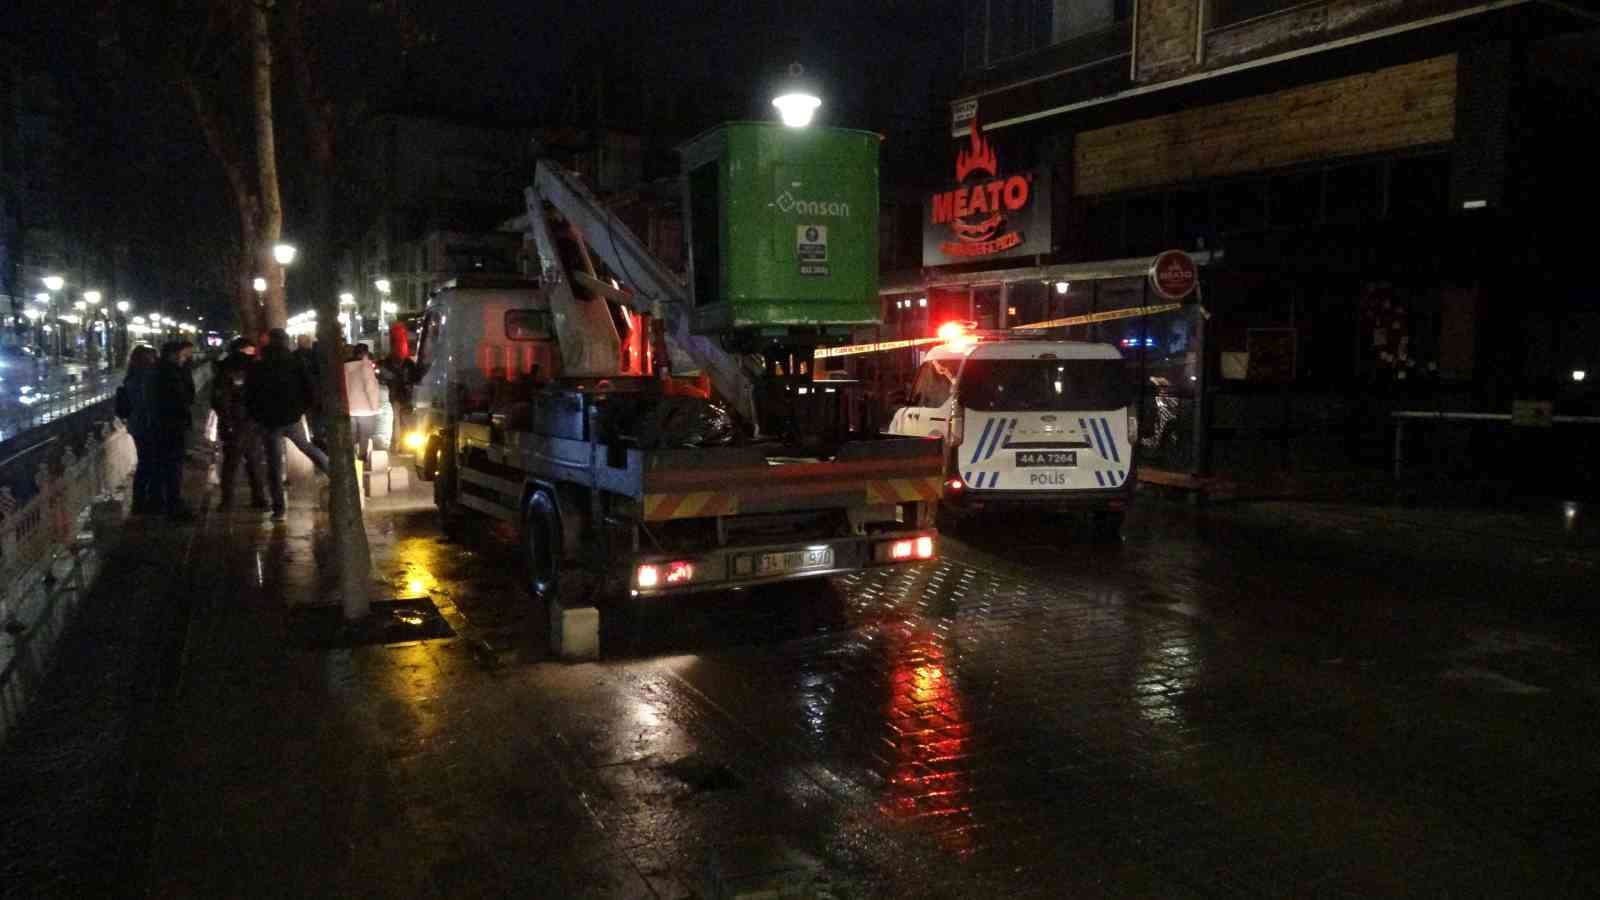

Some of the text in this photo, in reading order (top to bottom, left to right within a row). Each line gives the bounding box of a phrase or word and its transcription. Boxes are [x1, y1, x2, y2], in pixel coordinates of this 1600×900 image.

[931, 175, 1028, 224] MEATO
[796, 200, 849, 217] ansan
[1020, 453, 1035, 464] 44
[1037, 453, 1046, 464] A
[1030, 471, 1065, 485] POLİS
